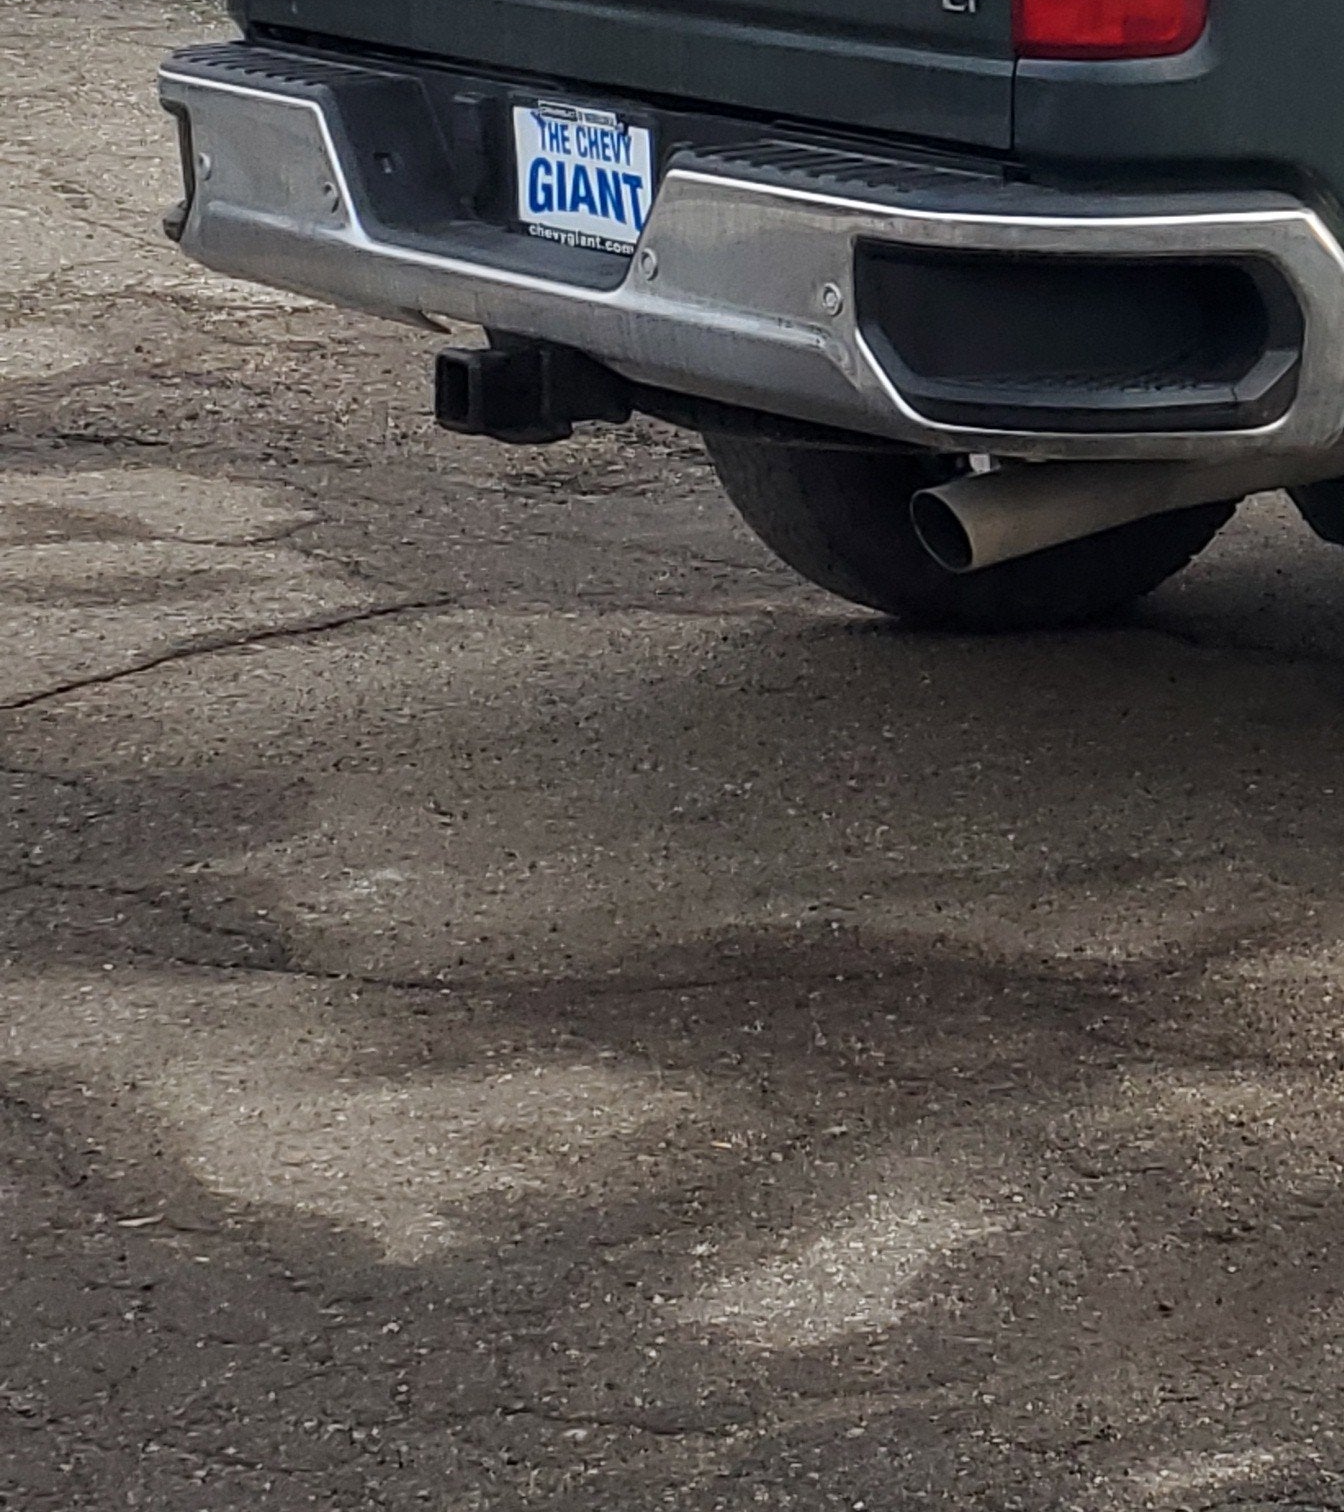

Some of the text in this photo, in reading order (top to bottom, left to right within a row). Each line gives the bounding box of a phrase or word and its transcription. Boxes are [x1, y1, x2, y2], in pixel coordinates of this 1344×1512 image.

[531, 110, 632, 167] THE CHEVY
[528, 156, 644, 232] GIANT
[528, 222, 634, 255] chevygiant.com
